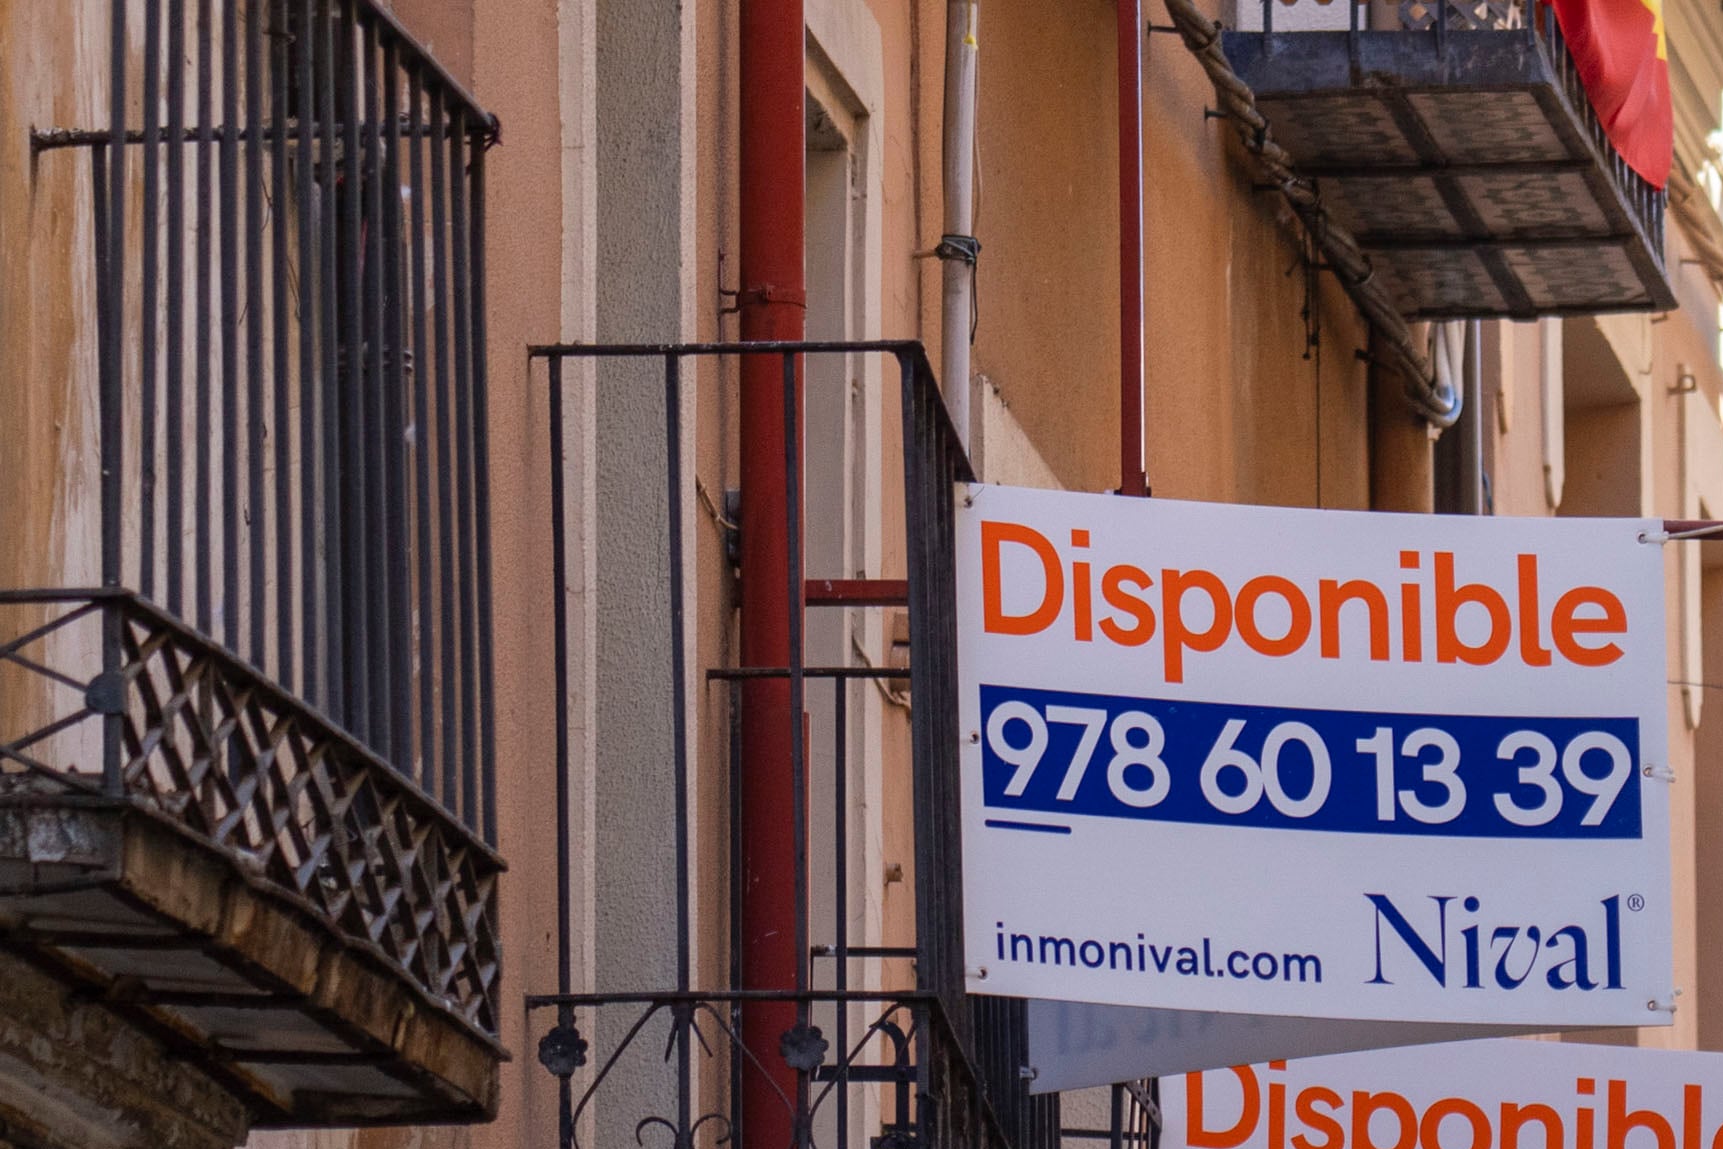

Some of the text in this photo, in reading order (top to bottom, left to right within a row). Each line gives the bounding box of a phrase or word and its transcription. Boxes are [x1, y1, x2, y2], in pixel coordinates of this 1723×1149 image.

[981, 521, 1627, 683] Disponible
[986, 700, 1632, 826] 978 60 13 39
[996, 922, 1323, 984] inmonival.com
